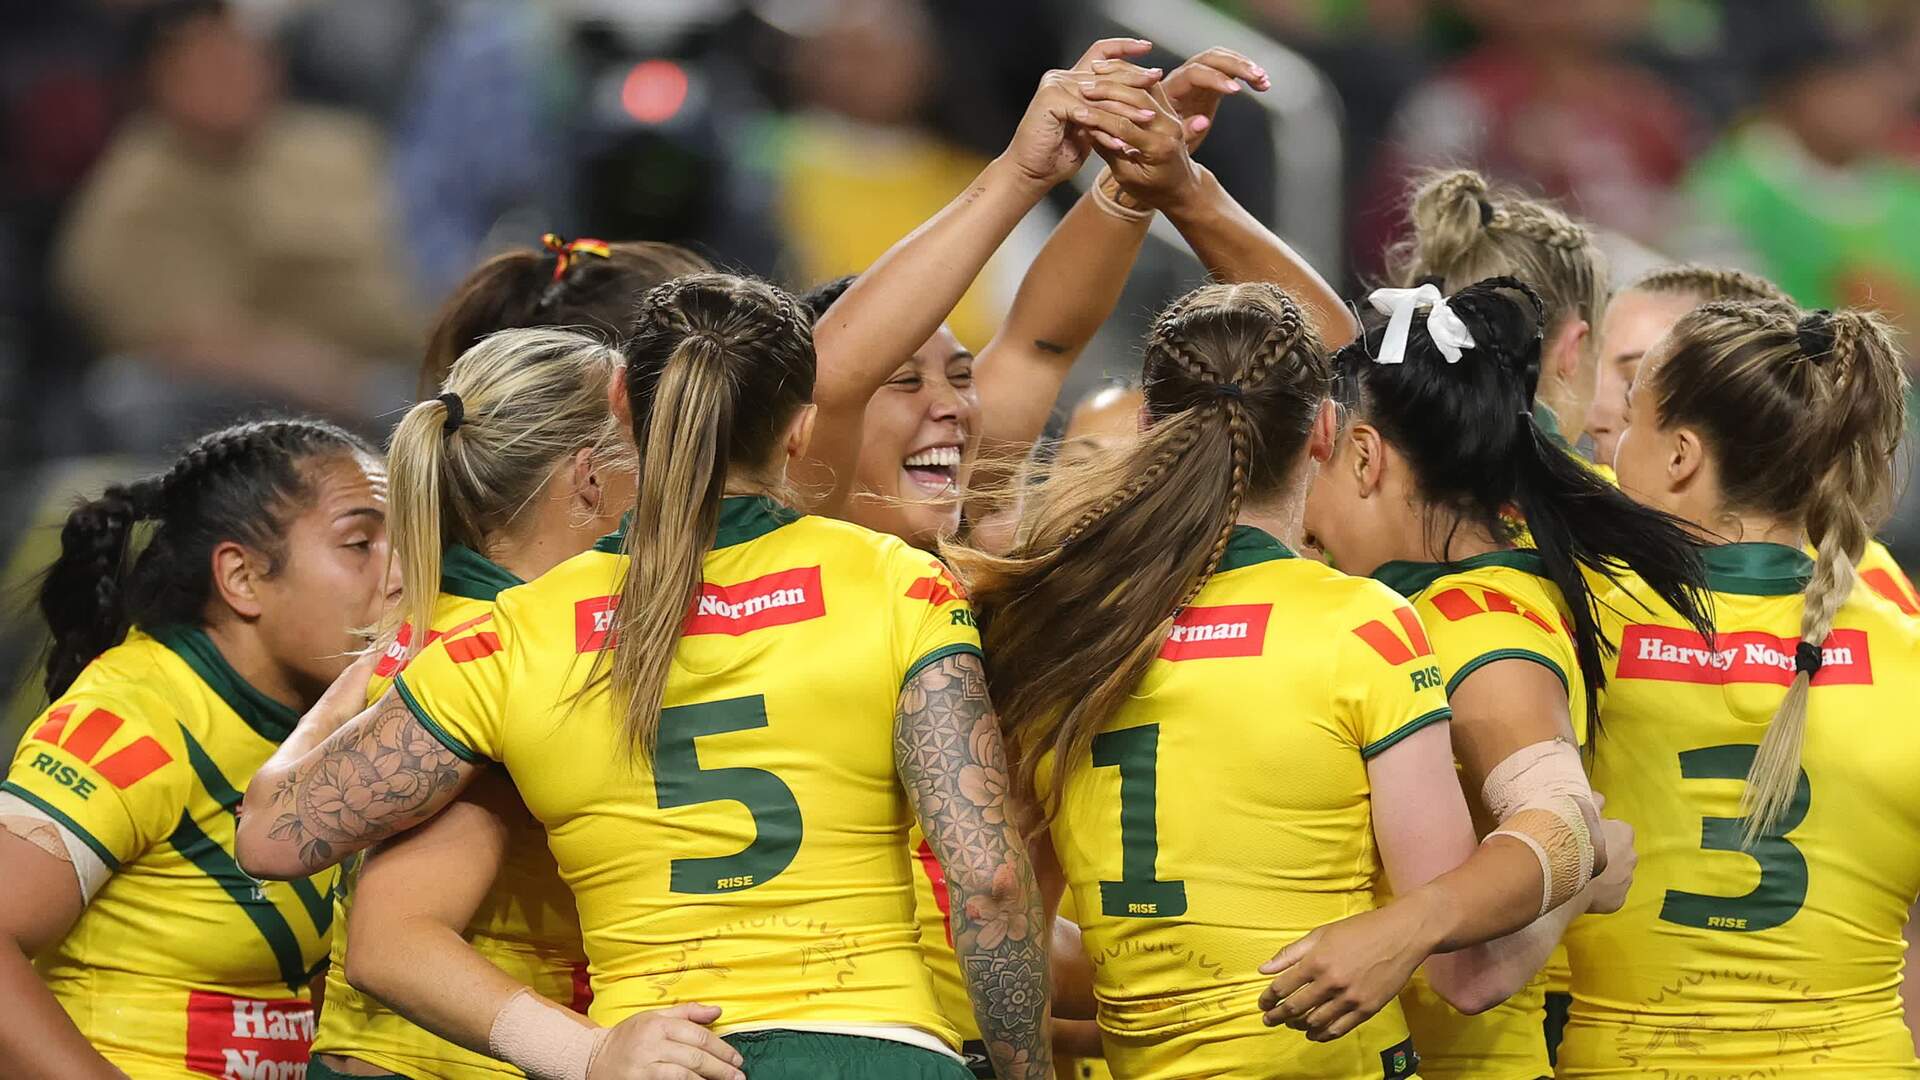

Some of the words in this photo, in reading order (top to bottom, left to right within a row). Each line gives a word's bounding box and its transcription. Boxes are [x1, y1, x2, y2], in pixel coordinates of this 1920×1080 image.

[697, 587, 805, 620] Norman
[1637, 637, 1738, 671] Harvey
[1410, 665, 1444, 693] RIS
[30, 752, 97, 801] RISE
[650, 693, 803, 895] 5
[1090, 722, 1188, 918] 1
[1658, 743, 1811, 932] 3
[717, 875, 753, 890] RISE
[1128, 903, 1158, 914] RISE
[1707, 916, 1748, 929] RISE
